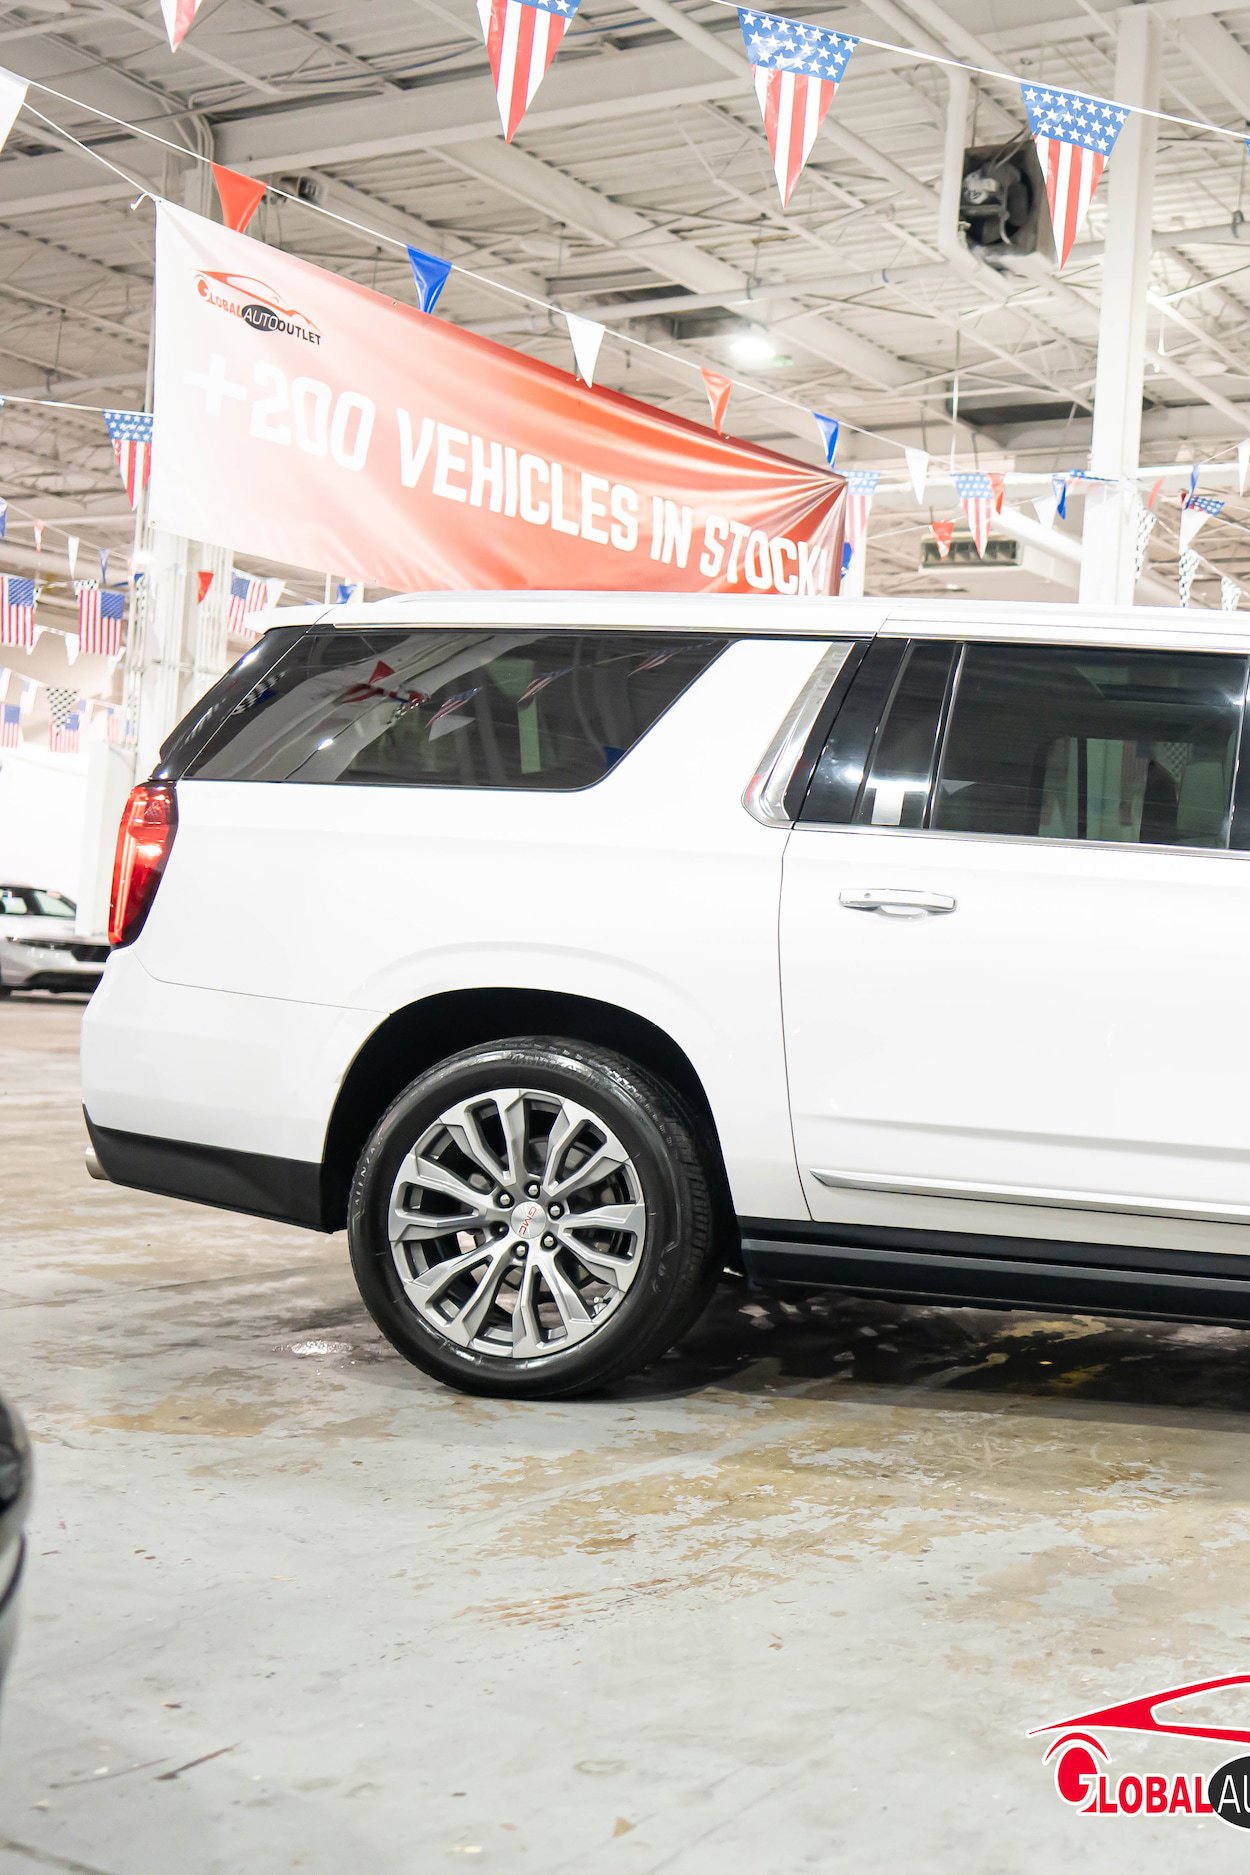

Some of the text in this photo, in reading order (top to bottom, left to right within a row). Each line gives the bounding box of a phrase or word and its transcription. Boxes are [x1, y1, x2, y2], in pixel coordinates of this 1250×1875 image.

[183, 351, 829, 597] +200 VEHICLES IN STOCK!
[518, 1206, 537, 1236] GMC
